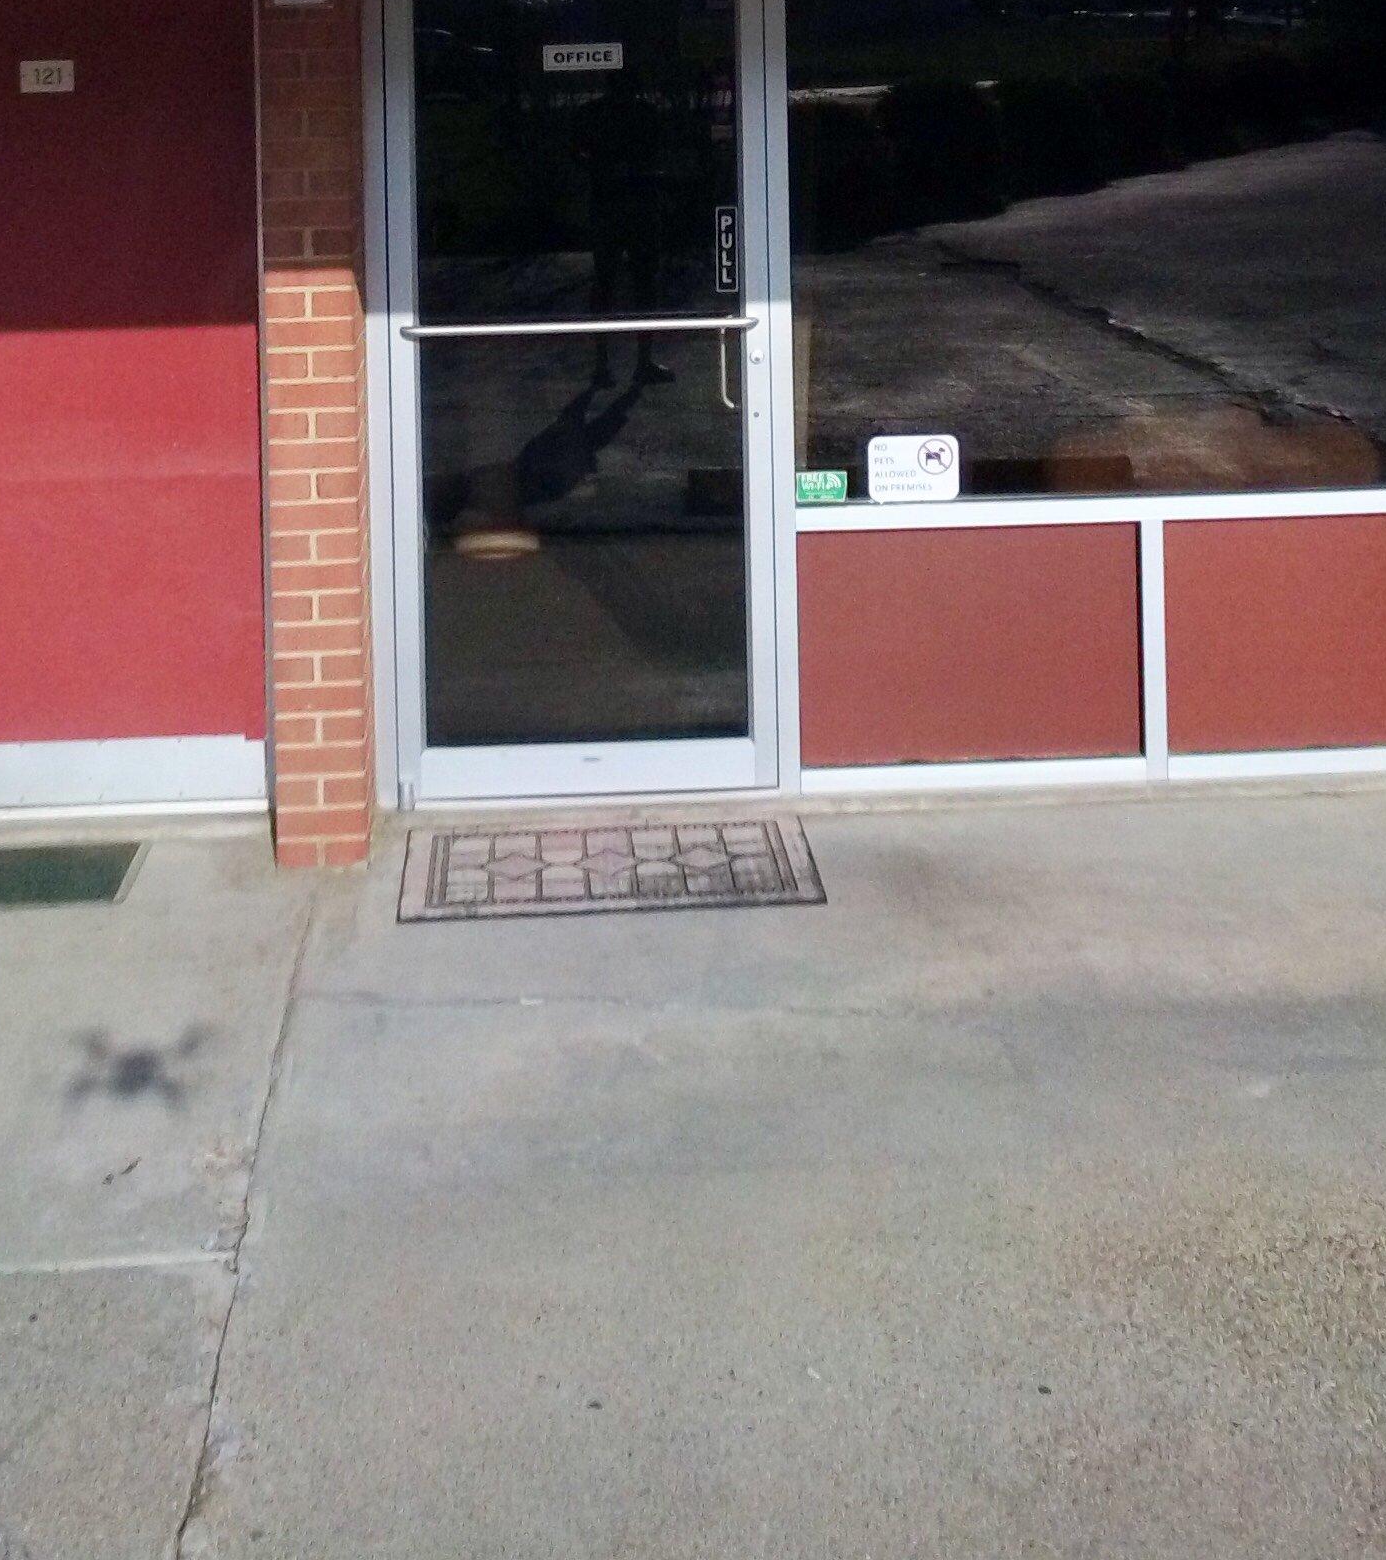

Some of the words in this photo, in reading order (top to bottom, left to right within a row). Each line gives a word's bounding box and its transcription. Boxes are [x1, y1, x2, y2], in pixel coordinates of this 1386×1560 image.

[553, 50, 613, 64] OFFICE
[34, 67, 61, 85] 121
[720, 215, 733, 284] PULL
[874, 443, 888, 452] NO
[874, 456, 895, 465] PETS
[874, 469, 917, 479] ALLOWED
[874, 483, 888, 493] ON
